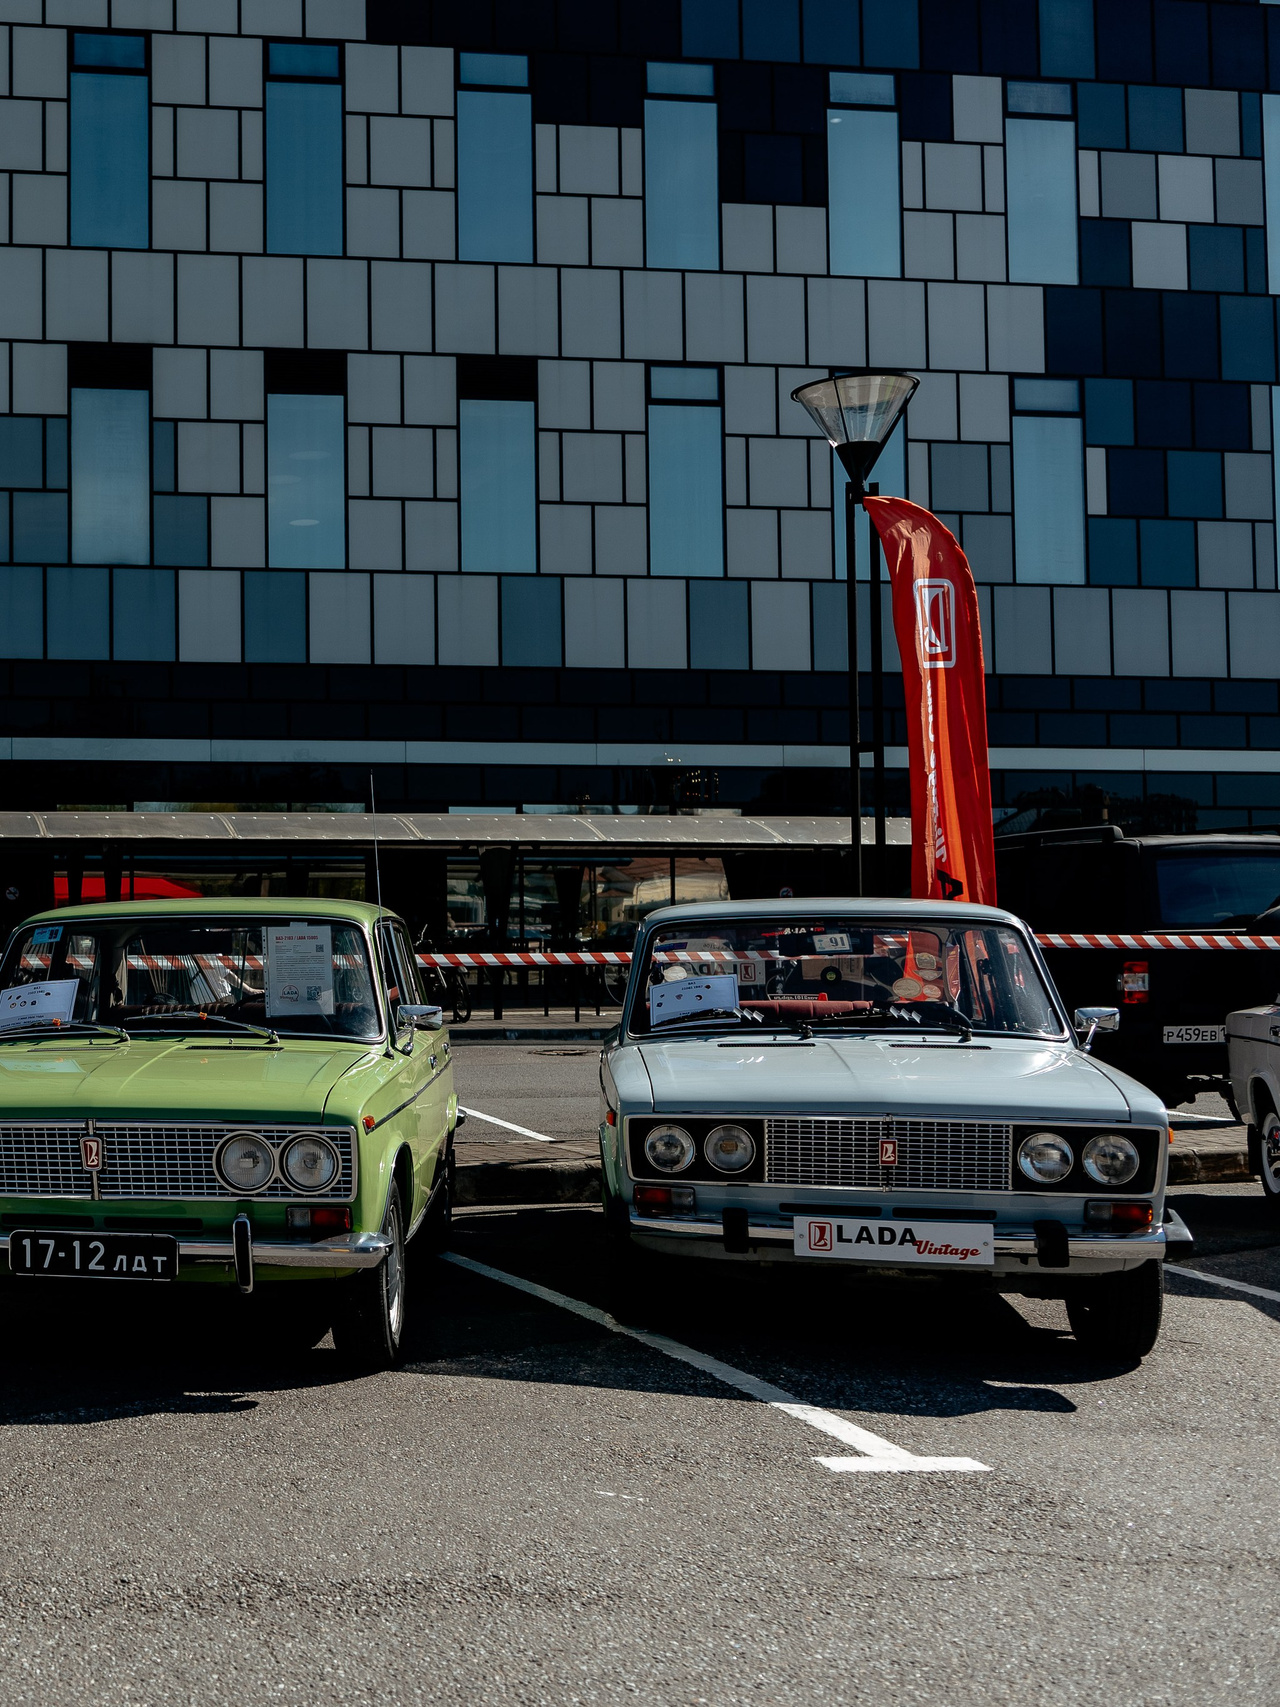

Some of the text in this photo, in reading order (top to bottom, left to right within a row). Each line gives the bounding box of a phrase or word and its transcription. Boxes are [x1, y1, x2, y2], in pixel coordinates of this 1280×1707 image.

[829, 936, 845, 947] 91
[1166, 1027, 1217, 1042] Р459ЕВ
[836, 1224, 981, 1260] LADA Vintage
[22, 1238, 106, 1271] 17-12
